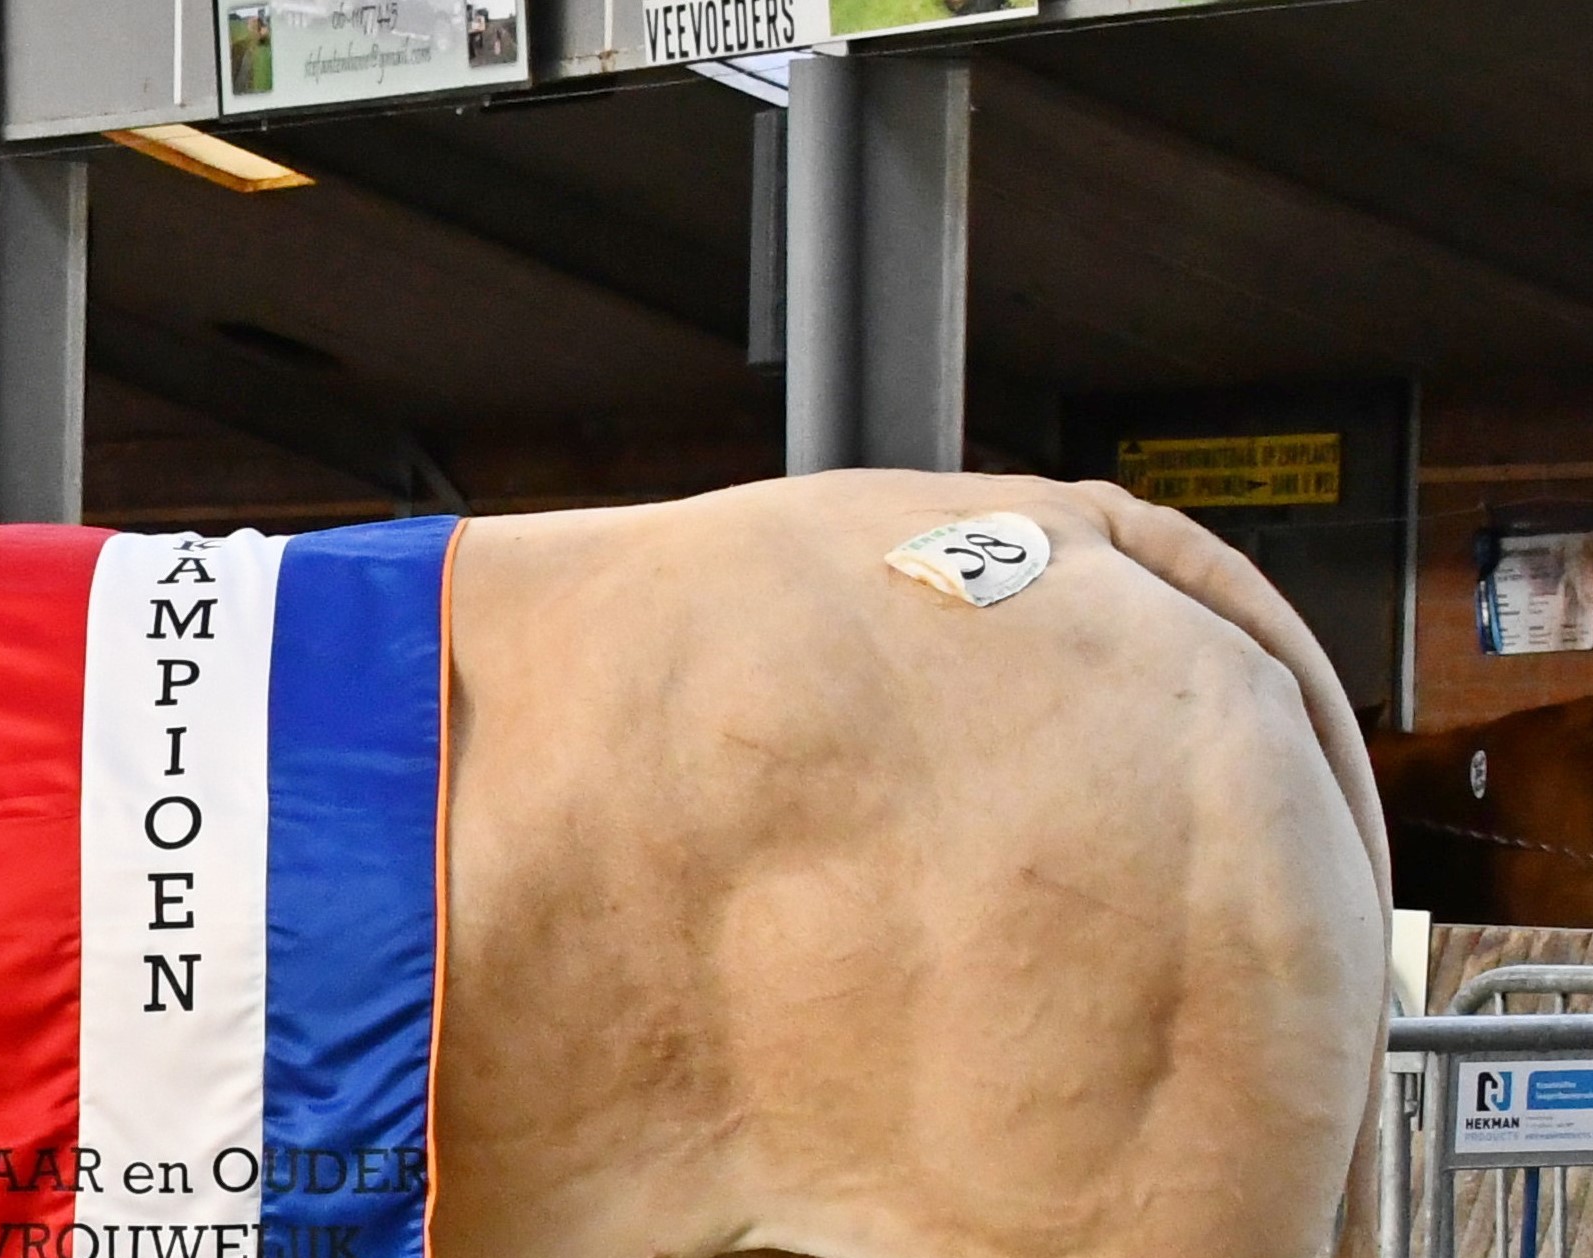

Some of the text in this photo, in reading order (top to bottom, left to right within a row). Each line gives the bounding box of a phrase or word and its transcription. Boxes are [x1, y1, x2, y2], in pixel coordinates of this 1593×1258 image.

[646, 0, 795, 62] VEEVOEDERS
[143, 539, 222, 1013] KAMPIOEN
[1465, 1117, 1520, 1130] HEKMAN
[123, 1159, 194, 1195] en
[212, 1146, 426, 1197] OUDER
